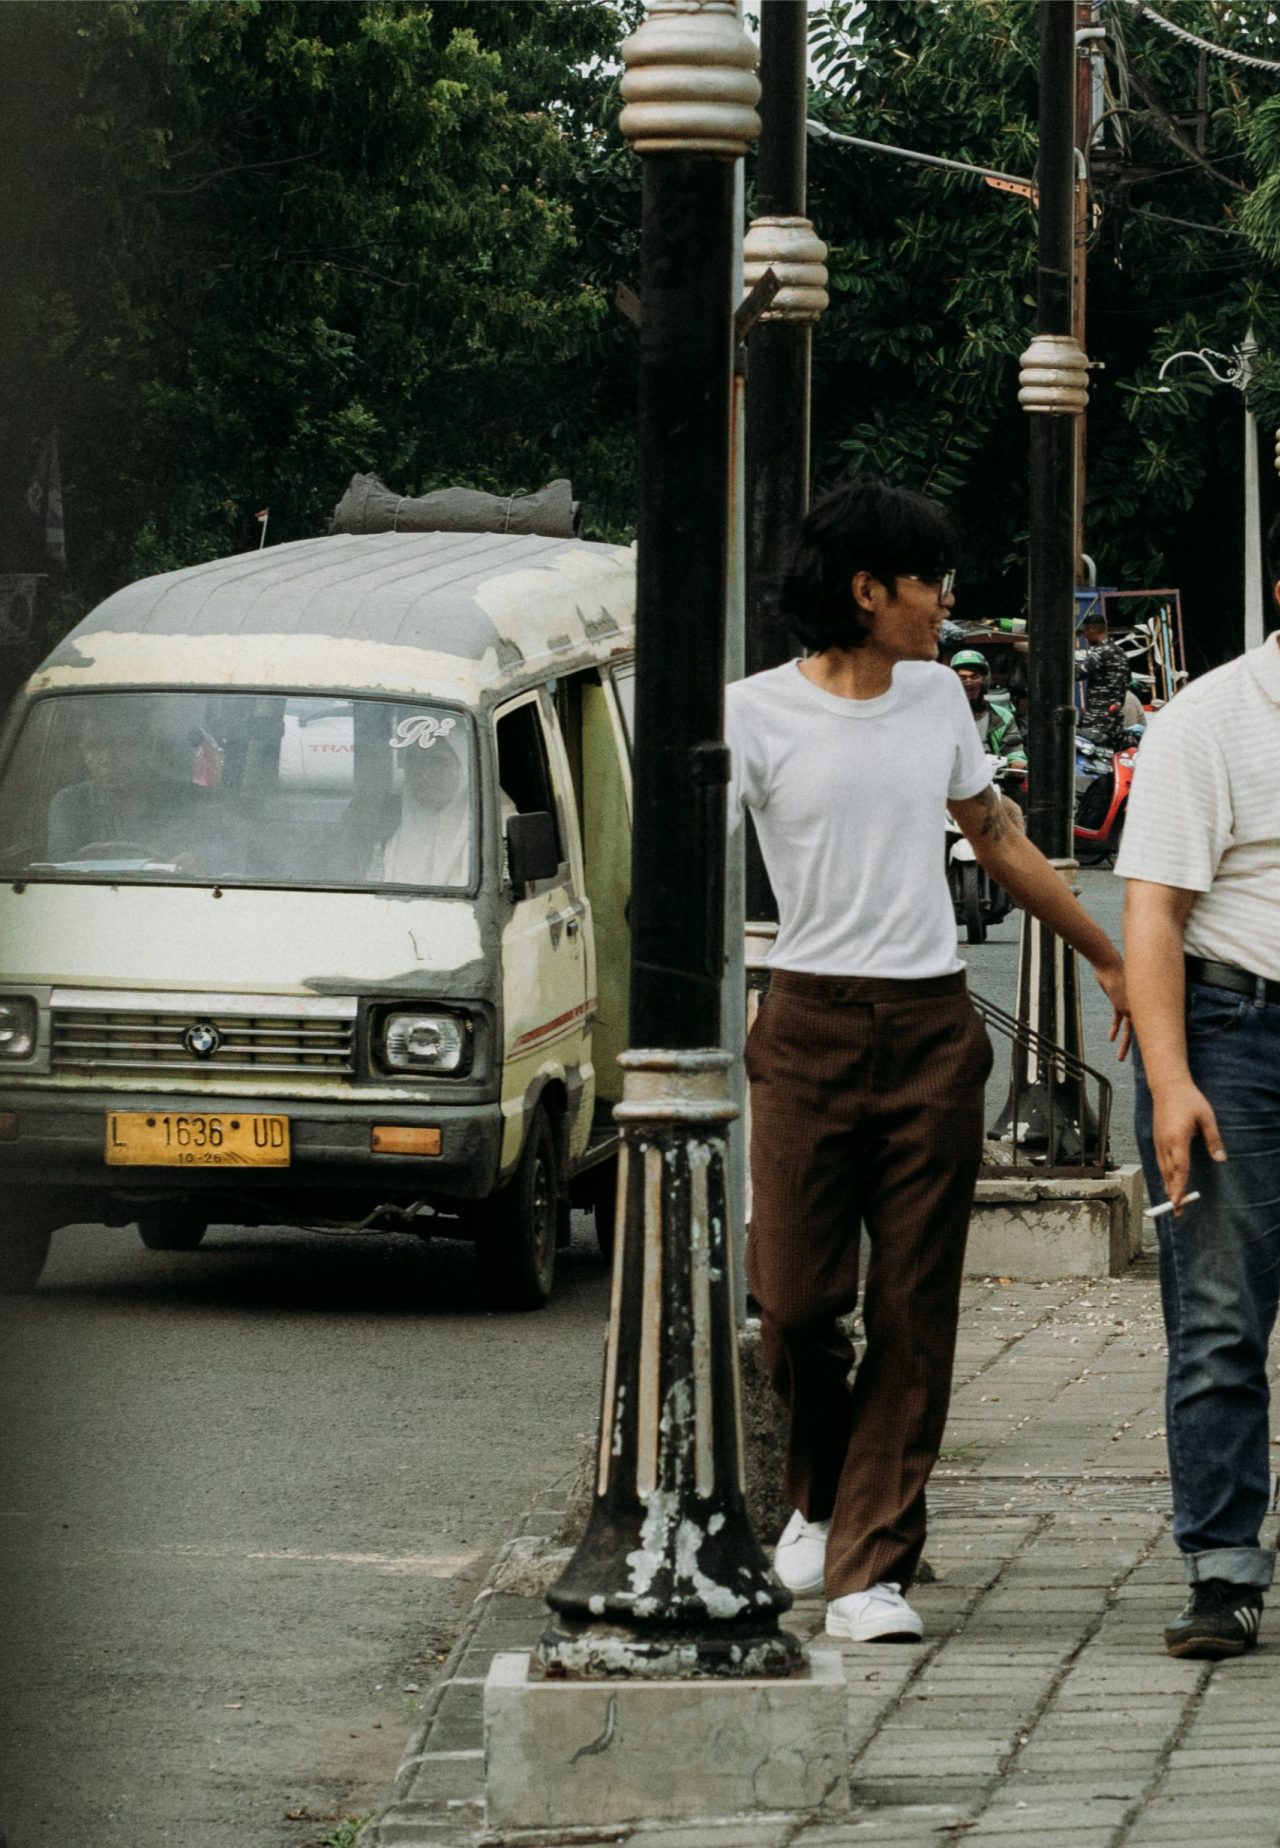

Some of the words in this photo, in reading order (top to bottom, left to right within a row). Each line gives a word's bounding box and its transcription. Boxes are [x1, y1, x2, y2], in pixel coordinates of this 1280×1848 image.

[112, 1116, 127, 1147] L
[162, 1117, 223, 1147] 1636
[253, 1118, 284, 1148] UD
